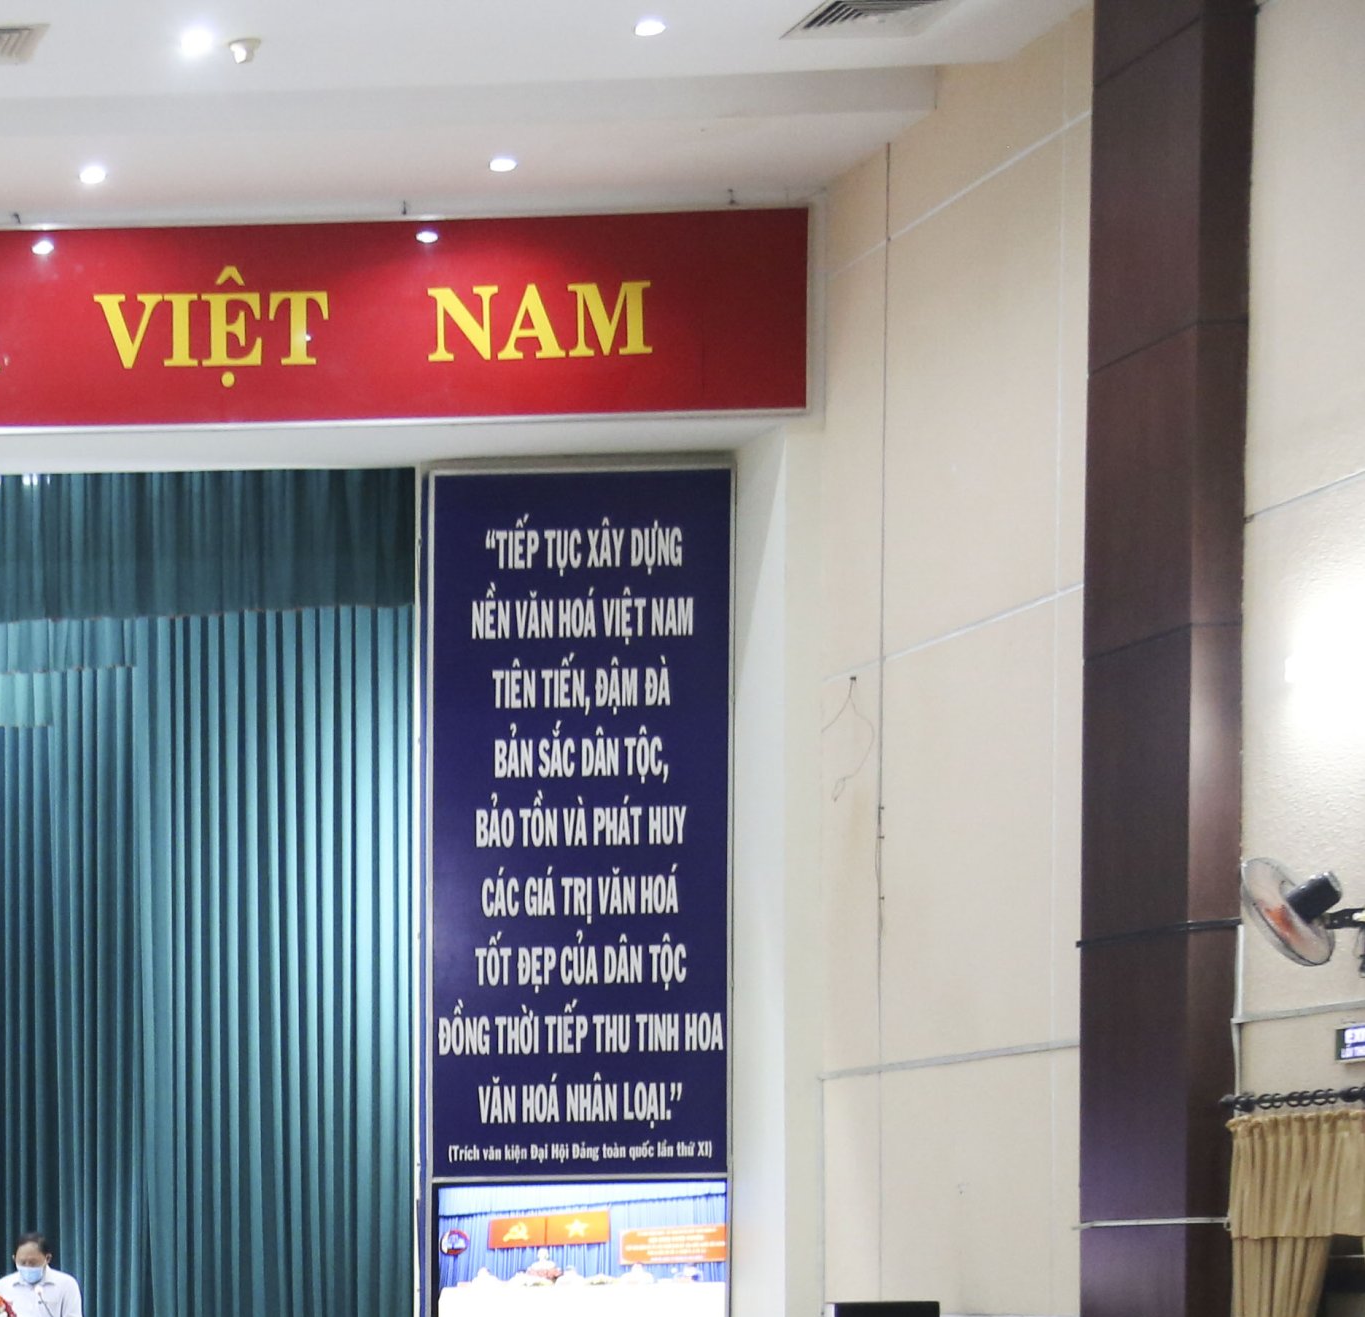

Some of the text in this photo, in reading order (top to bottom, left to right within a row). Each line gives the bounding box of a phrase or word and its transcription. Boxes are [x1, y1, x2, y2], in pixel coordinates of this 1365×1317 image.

[93, 266, 329, 388] VIỆT
[427, 280, 654, 364] NAM
[544, 529, 581, 576] TỤC
[587, 517, 624, 567] XÂY
[631, 520, 682, 574] DỰNG
[472, 582, 693, 645] NỀN VĂN HOÁ VIỆT NAM
[492, 653, 670, 715] TIÊN TIẾN, ĐẬM ĐÀ
[495, 720, 668, 783] BẢN SẮC DÂN TỘC,
[476, 790, 686, 847] BẢO TỒN VÀ PHÁT HUY
[482, 864, 678, 924] CÁC GIÁ TRỊ VĂN HOÁ
[475, 930, 686, 993] TỐT ĐẸP CỦA DÂN TỘC
[438, 999, 723, 1055] ĐỒNG THỜI TIẾP THU TINH HOA
[478, 1077, 516, 1123] VĂN
[523, 1073, 559, 1122] HOÁ
[567, 1072, 617, 1122] NHÂN
